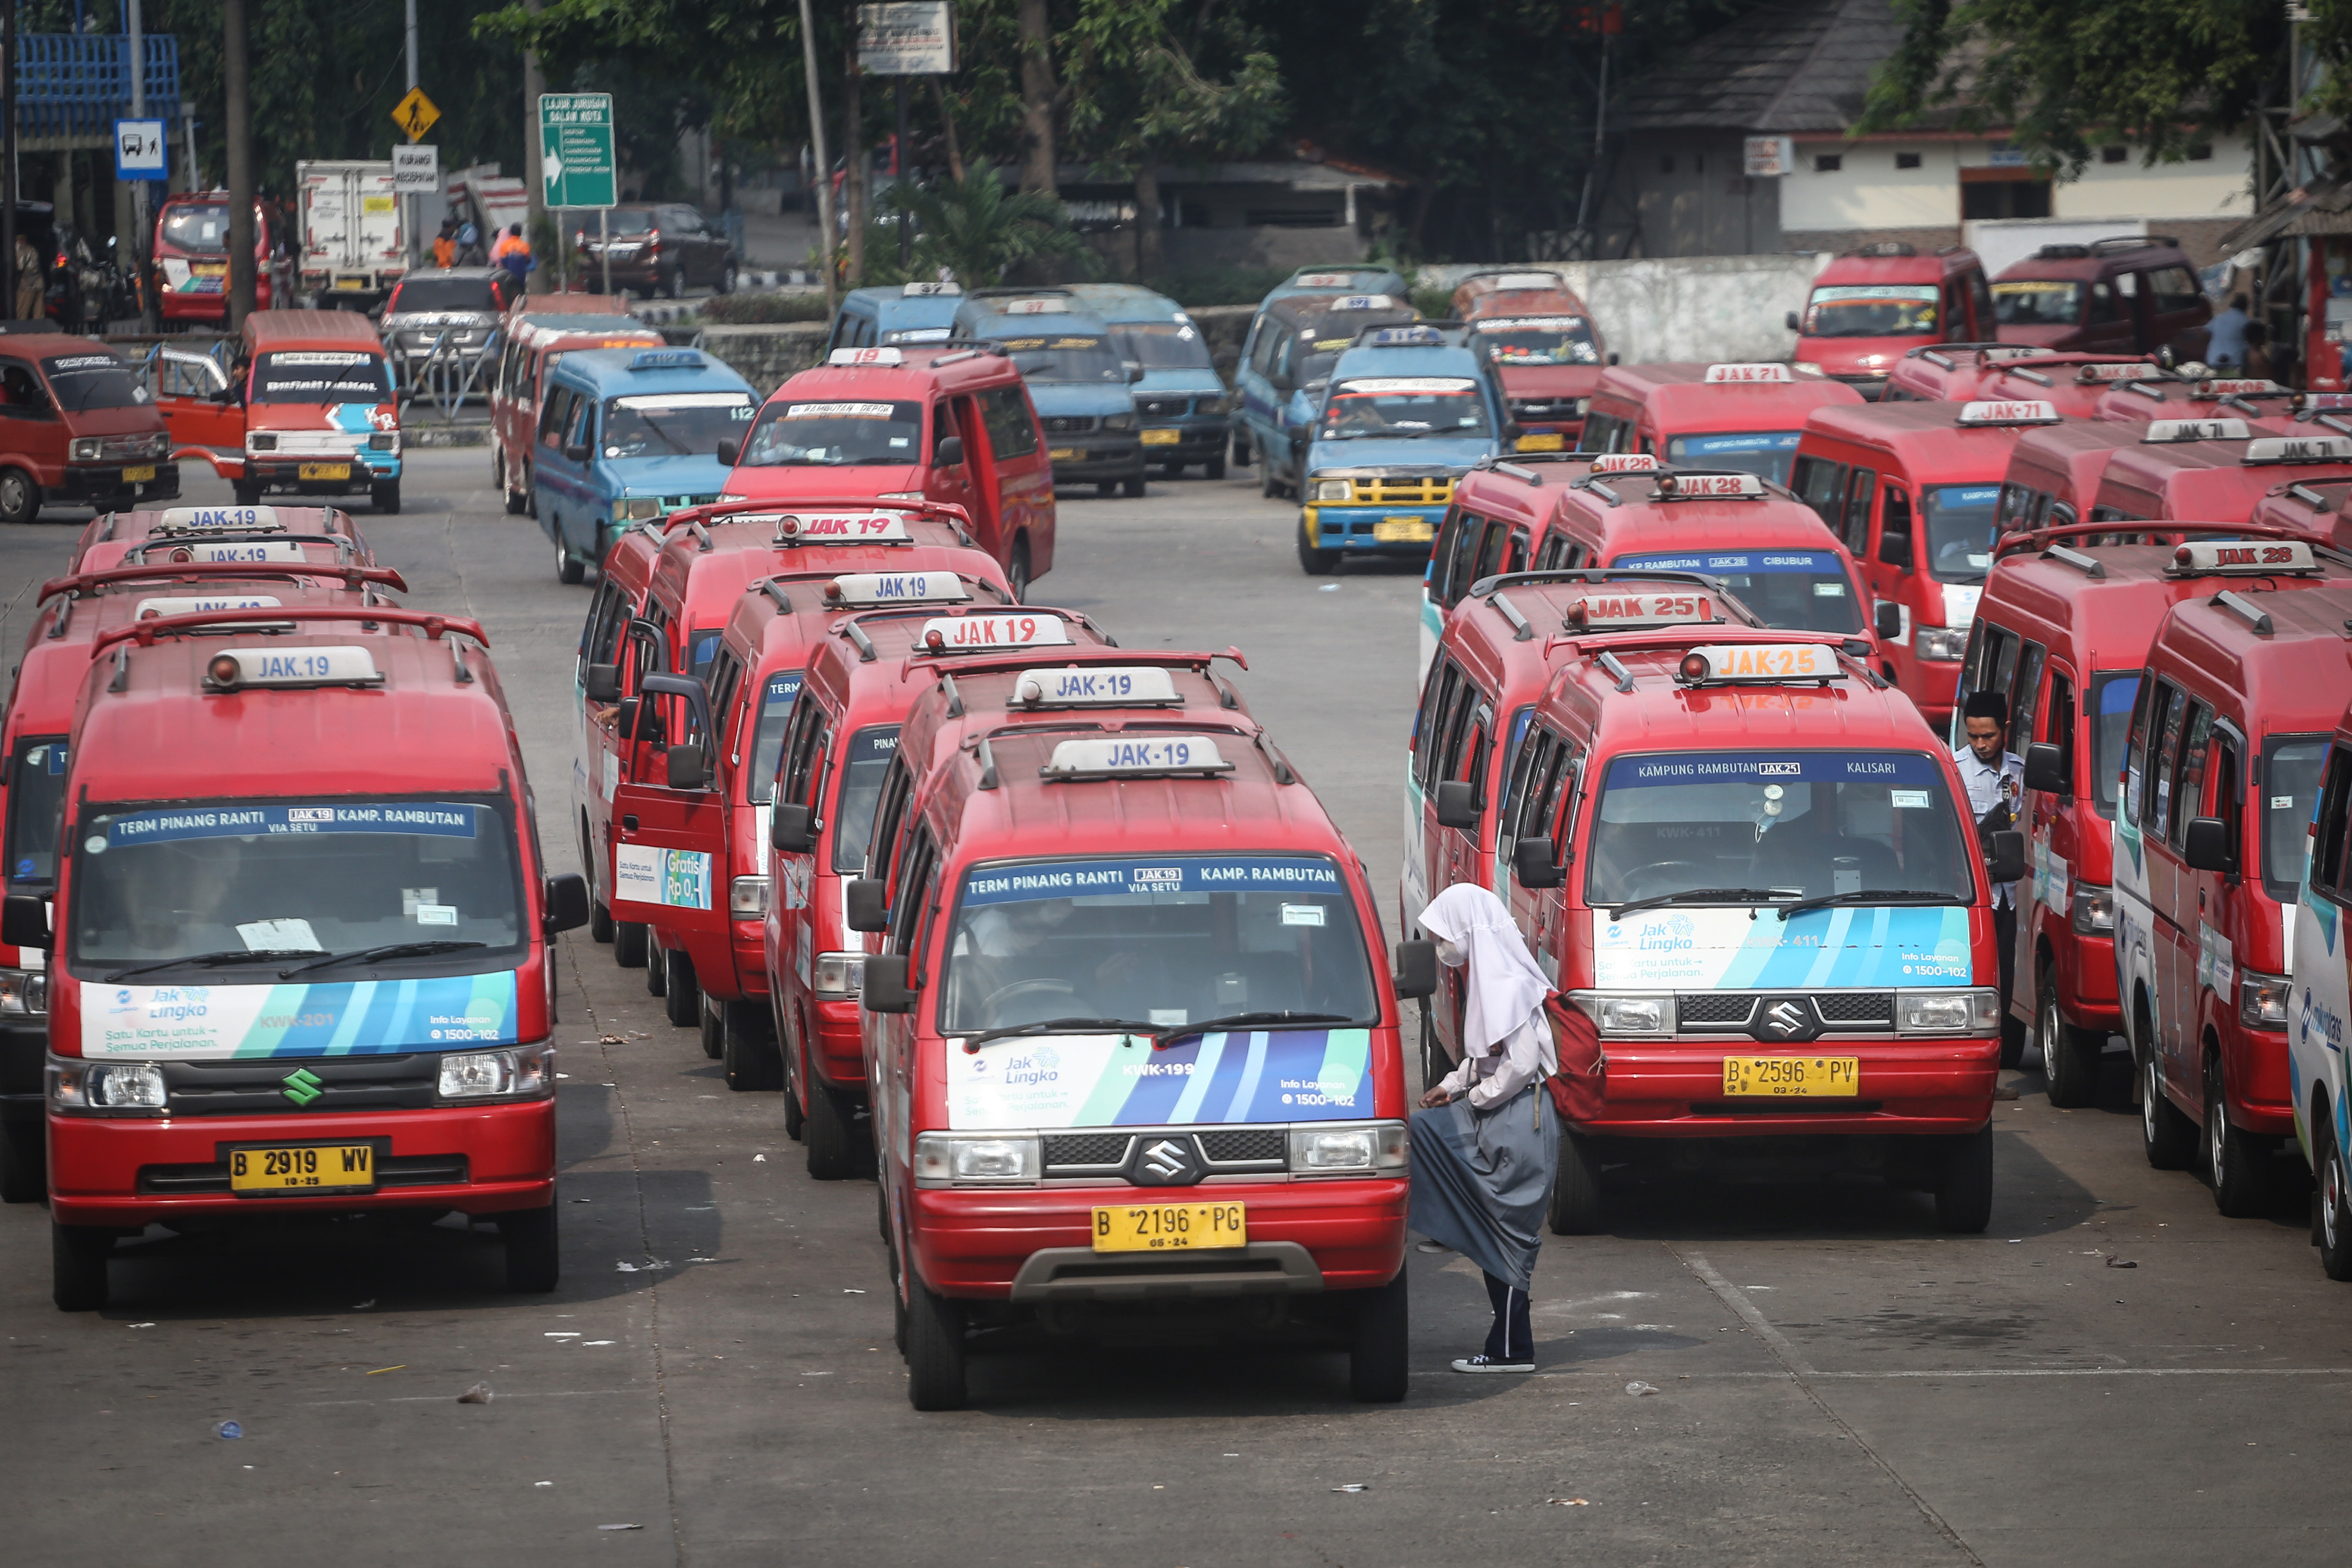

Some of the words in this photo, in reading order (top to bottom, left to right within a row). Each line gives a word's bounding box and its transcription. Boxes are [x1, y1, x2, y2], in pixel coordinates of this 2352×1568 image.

[544, 98, 570, 110] LAJUR
[572, 97, 607, 110] JURUSAN
[580, 110, 602, 122] KOTA
[854, 348, 881, 363] 19
[1715, 367, 1754, 381] JAK
[1759, 367, 1780, 380] 71
[804, 403, 856, 413] RAMBUTAN
[860, 404, 893, 413] DEPOK
[1980, 402, 2041, 420] JAK-71
[1602, 457, 1628, 471] JAK
[1629, 457, 1653, 470] 28
[1679, 477, 1713, 495] JAK
[1715, 477, 1742, 494] 28
[1961, 490, 1999, 500] KAMPUNG
[189, 509, 256, 527] JAK.19
[803, 520, 854, 536] JAK
[856, 518, 890, 534] 19
[1645, 559, 1700, 570] RAMBUTAN
[1762, 556, 1813, 566] CIBUBUR
[2215, 548, 2257, 567] JAK
[2261, 546, 2293, 564] 28
[875, 577, 905, 598] JAK
[908, 576, 927, 597] 19
[1588, 597, 1645, 618] JAK
[1654, 596, 1695, 616] 25
[953, 618, 997, 645] JAK
[1005, 617, 1036, 643] 19
[258, 656, 329, 677] JAK.19
[1720, 649, 1816, 675] JAK-25
[770, 681, 801, 694] TERM
[1057, 673, 1132, 697] JAK-19
[1108, 743, 1190, 766] JAK-19
[1638, 764, 1694, 777] KAMPUNG
[1698, 762, 1758, 775] RAMBUTAN
[1763, 763, 1797, 774] JAK.25
[1847, 762, 1896, 774] KALISARI
[117, 820, 158, 835] TERM
[159, 814, 217, 830] PINANG
[219, 811, 265, 825] RANTI
[292, 810, 330, 820] JAK.19
[336, 809, 382, 822] KAMP.
[385, 810, 466, 825] RAMBUTAN
[268, 824, 289, 833] VIA
[290, 823, 318, 832] SETU
[667, 852, 700, 875] Gratis
[969, 878, 1010, 894] TERM
[1012, 872, 1074, 890] PINANG
[1075, 870, 1124, 885] RANTI
[1140, 870, 1176, 880] JAK.19
[1200, 867, 1248, 881] KAMP.
[1251, 868, 1336, 882] RAMBUTAN
[1128, 883, 1148, 892] VIA
[1151, 882, 1180, 892] SETU
[667, 876, 681, 901] Rp
[1639, 923, 1667, 937] Jak
[1639, 937, 1693, 953] Lingko
[1661, 957, 1692, 967] untuk
[1901, 952, 1918, 962] Info
[1920, 953, 1959, 965] Layanan
[1641, 968, 1703, 980] Perjalanan.
[1915, 965, 1967, 978] 1500-102
[150, 988, 180, 1002] Jak
[149, 1004, 208, 1021] Lingko
[260, 1013, 335, 1029] KWK-201
[430, 1015, 449, 1024] Info
[450, 1015, 490, 1027] Layanan
[105, 1029, 133, 1040] Satu
[136, 1028, 168, 1038] Kartu
[172, 1027, 206, 1037] untuk
[443, 1028, 499, 1041] 1500-102
[105, 1041, 146, 1052] Semua
[149, 1038, 218, 1051] Perjalanan.
[1004, 1056, 1033, 1071] Jak
[1122, 1062, 1195, 1076] KWK-199
[1727, 1060, 1739, 1082] B
[1758, 1059, 1805, 1083] 2596
[1830, 1061, 1853, 1083] PV
[1005, 1069, 1058, 1085] Lingko
[1280, 1078, 1299, 1089] Info
[1302, 1078, 1346, 1091] Layanan
[1025, 1089, 1058, 1099] untuk
[1295, 1094, 1355, 1107] 1500-102
[232, 1152, 248, 1176] B
[265, 1149, 316, 1175] 2919
[341, 1146, 368, 1172] WV
[1097, 1211, 1110, 1236] B
[1135, 1207, 1189, 1235] 2196
[1213, 1205, 1240, 1232] PG
